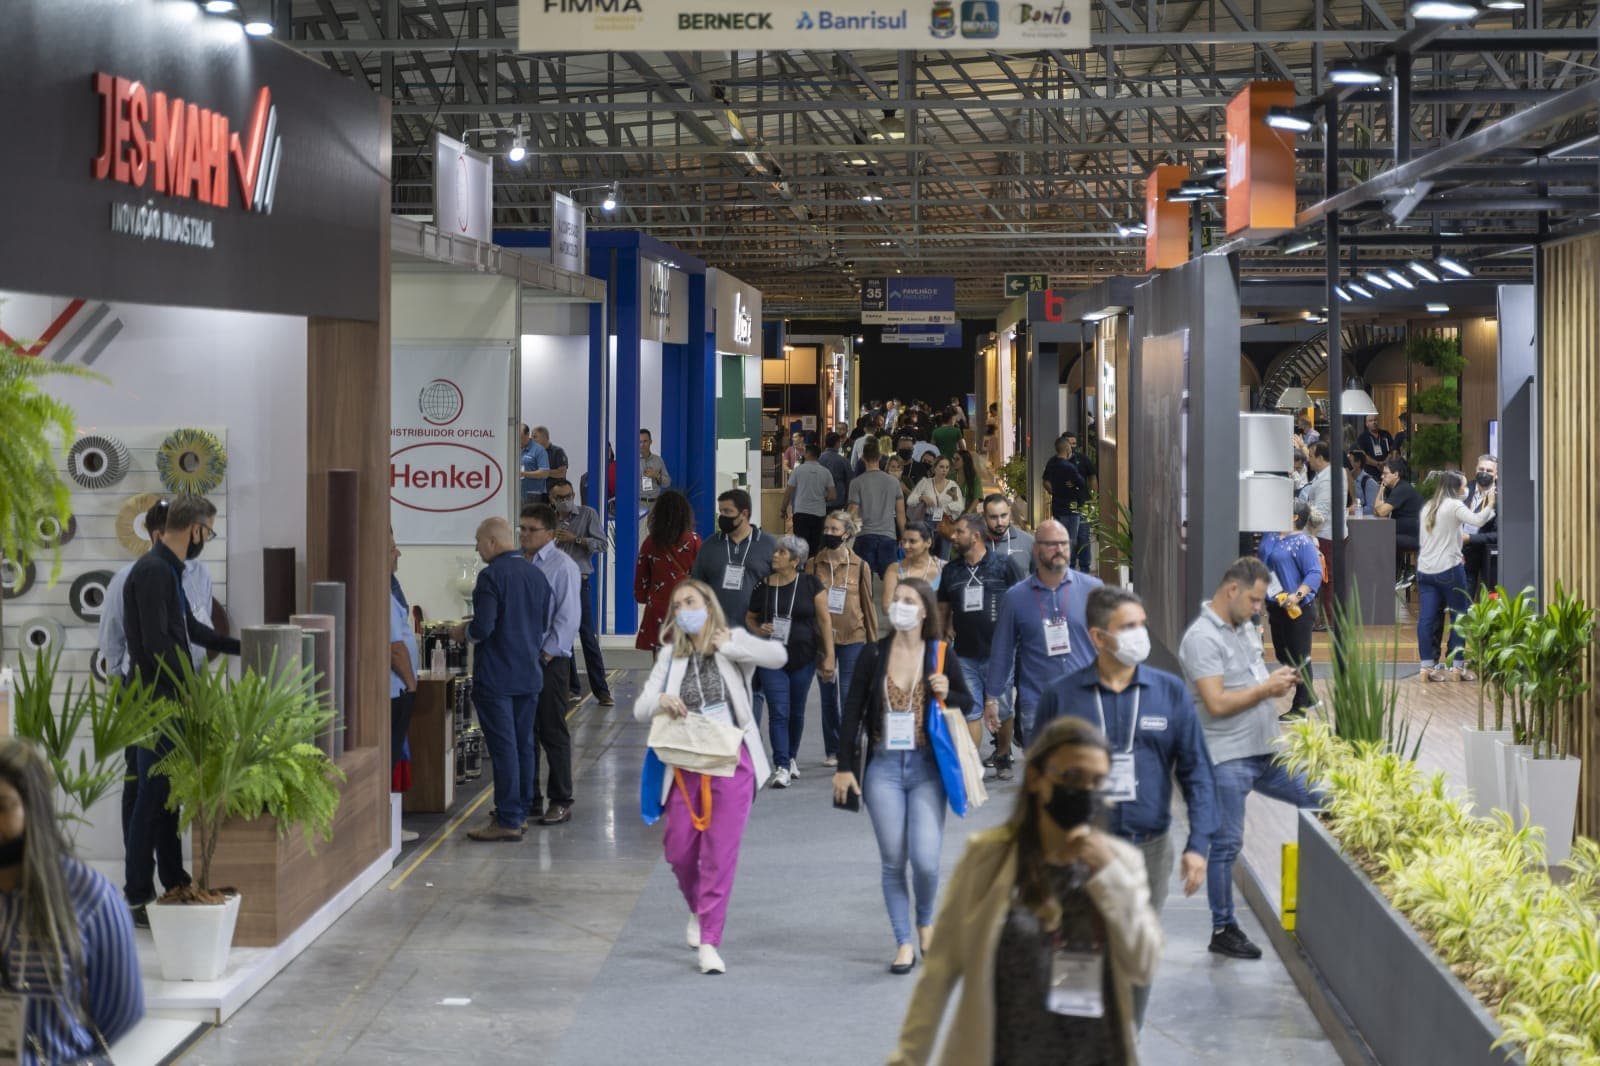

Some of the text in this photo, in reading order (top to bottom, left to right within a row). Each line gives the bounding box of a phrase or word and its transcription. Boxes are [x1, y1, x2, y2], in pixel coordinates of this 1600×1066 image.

[677, 12, 773, 31] BERNECK
[818, 9, 907, 29] Banrisul
[866, 288, 882, 299] 35
[457, 428, 495, 438] OFICIAL
[390, 463, 490, 489] Henkel
